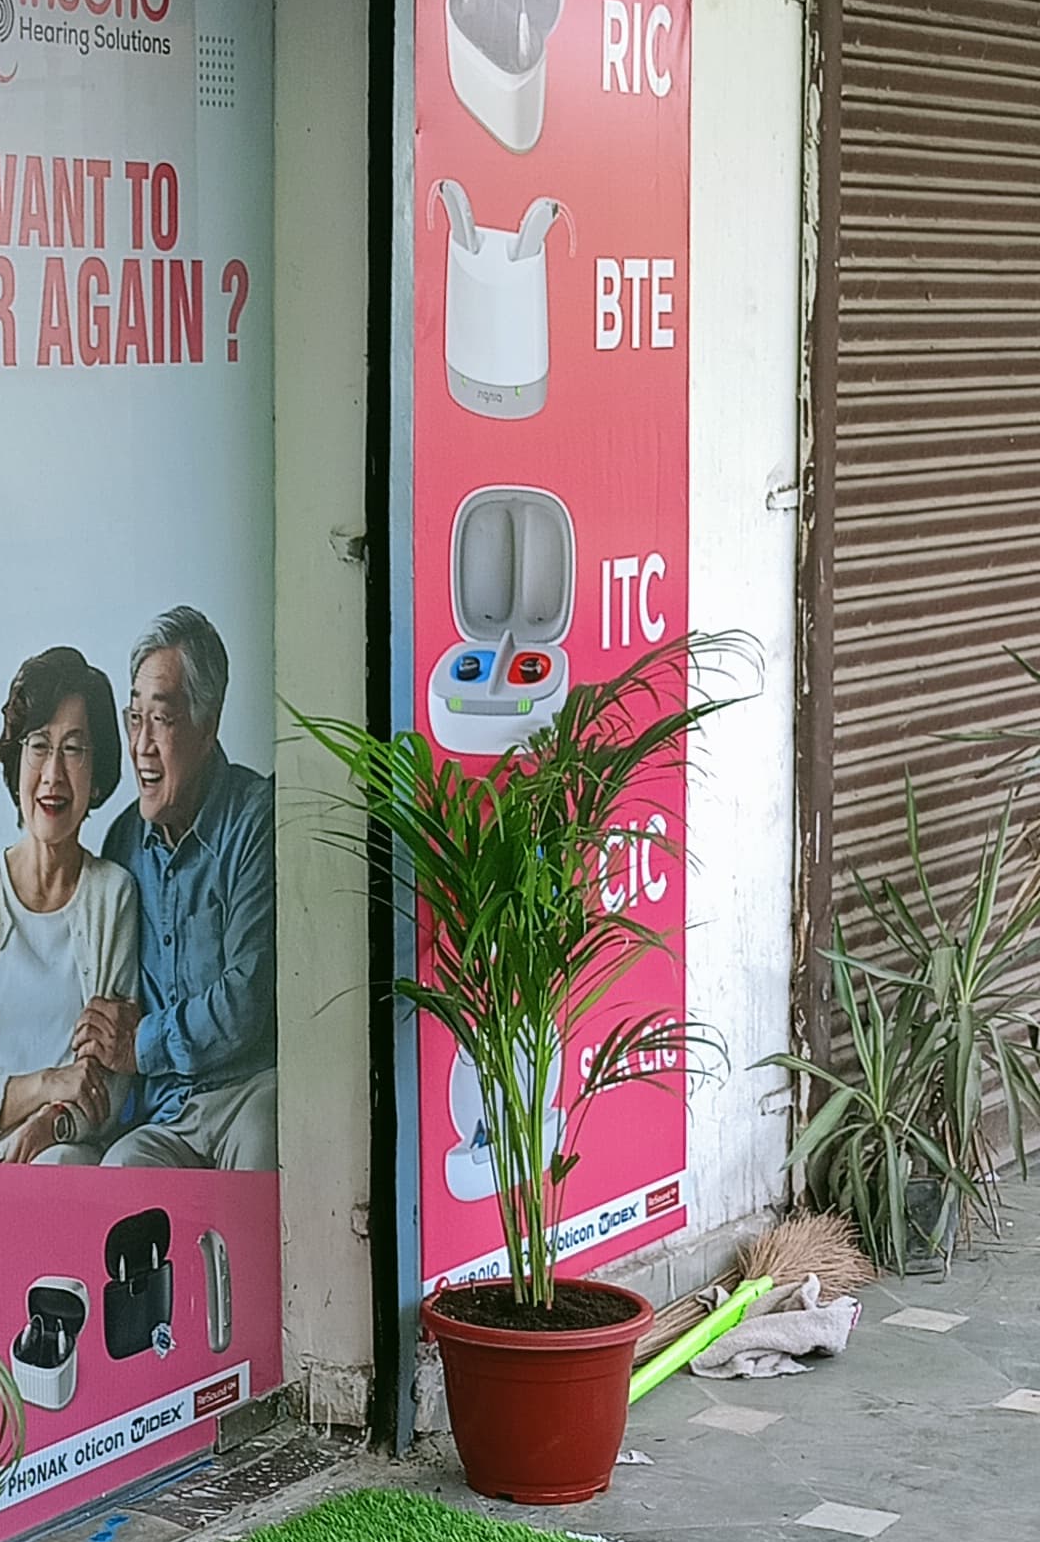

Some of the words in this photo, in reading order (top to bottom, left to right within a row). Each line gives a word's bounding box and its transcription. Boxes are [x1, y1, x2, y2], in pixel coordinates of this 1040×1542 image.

[19, 16, 91, 56] Hearing
[93, 24, 172, 56] Solutions
[124, 160, 179, 252] TO
[36, 255, 205, 366] AGAIN
[220, 258, 250, 363] ?
[595, 257, 675, 350] BTE
[602, 553, 666, 650] ITC
[598, 813, 668, 914] CIC
[557, 1223, 595, 1252] oticon
[598, 1205, 639, 1236] WIDEX
[8, 1452, 69, 1498] PHONAK
[74, 1431, 125, 1467] oticon
[130, 1403, 183, 1444] WIDEX
